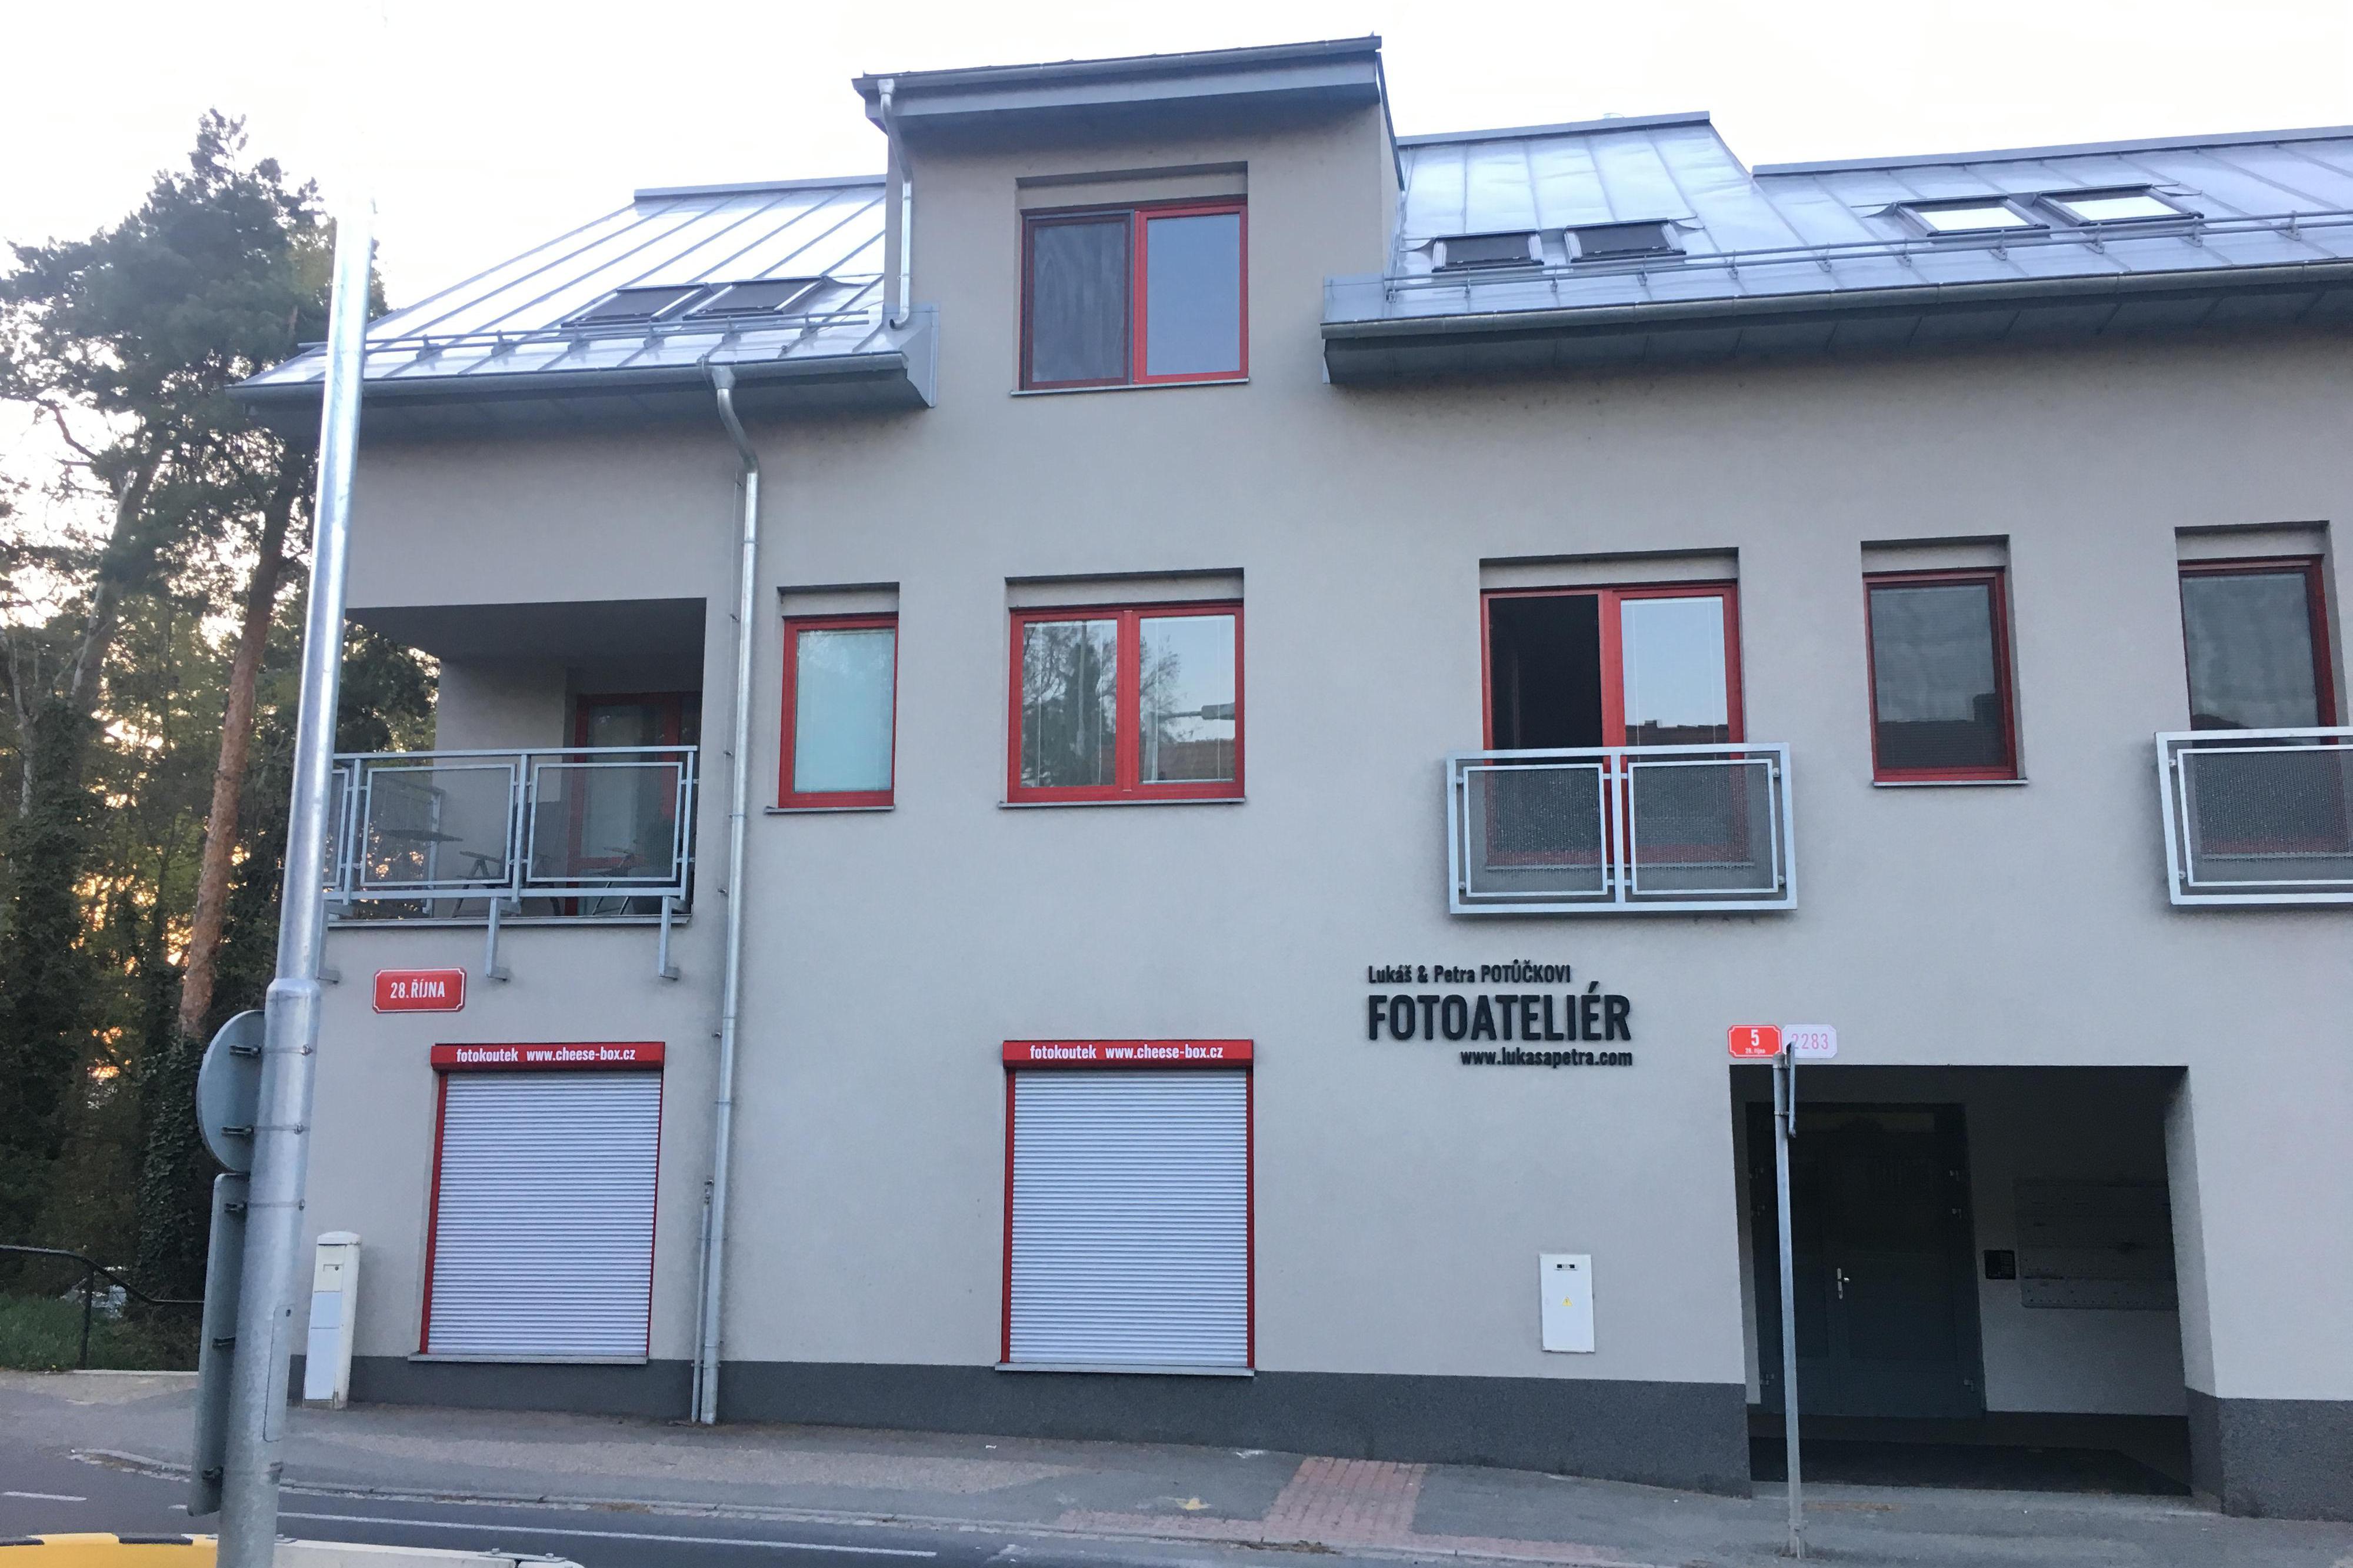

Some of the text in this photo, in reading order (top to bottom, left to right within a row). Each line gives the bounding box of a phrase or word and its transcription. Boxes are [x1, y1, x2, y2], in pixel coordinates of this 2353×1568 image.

[1368, 959, 1571, 983] Lukáš & Petra POTŮČKOVI
[1368, 981, 1632, 1040] FOTOATELIÉR
[1751, 1029, 1759, 1046] 5
[1791, 1033, 1829, 1050] 2283
[456, 1046, 635, 1062] fotokoutek www.cheese-box.cz
[1030, 1044, 1223, 1059] fotokoutek www.cheese-box.cz
[1461, 1047, 1632, 1068] www.lukasapetra.com
